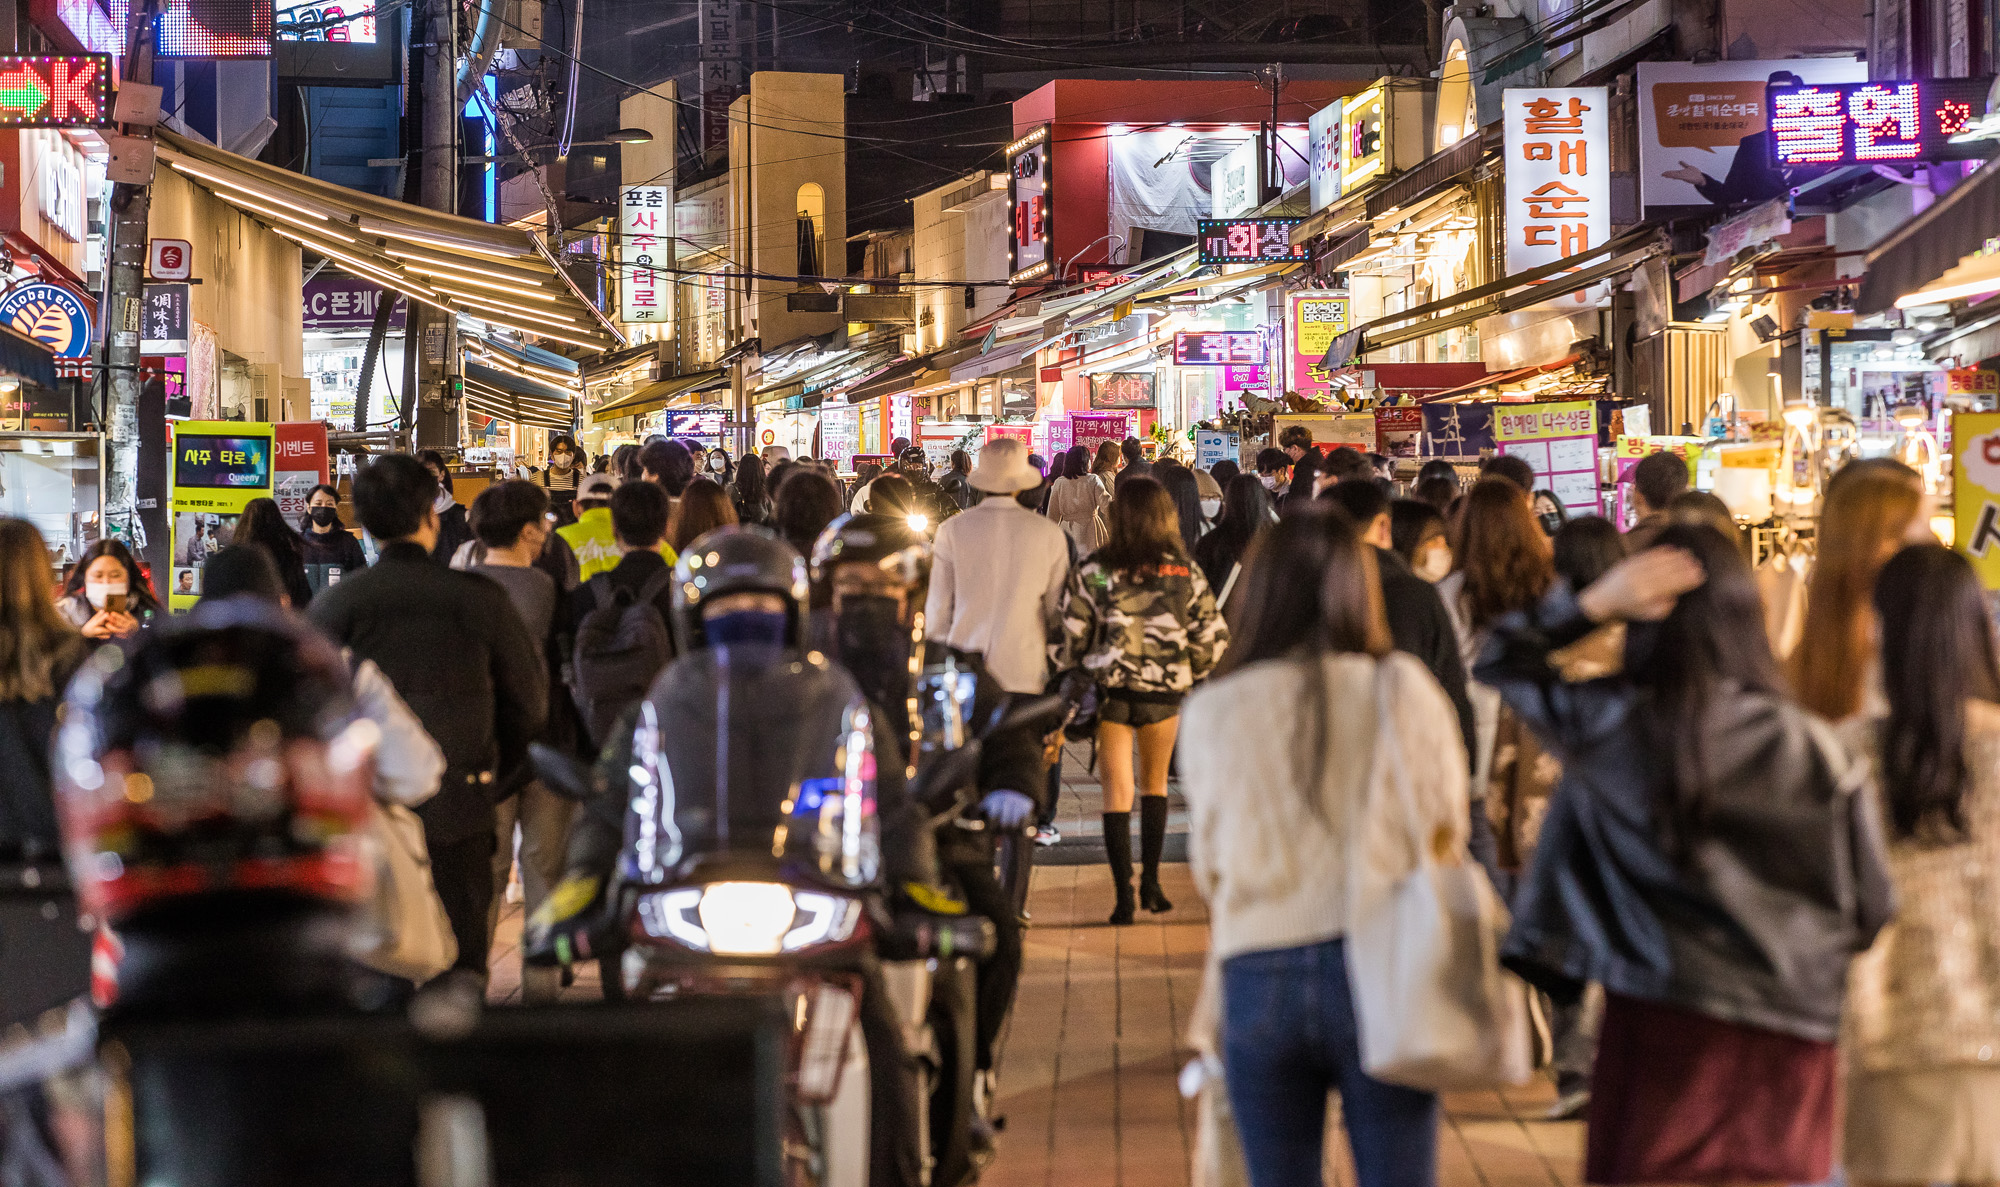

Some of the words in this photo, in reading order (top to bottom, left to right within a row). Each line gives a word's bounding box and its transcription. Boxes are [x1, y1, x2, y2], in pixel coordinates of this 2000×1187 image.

[53, 61, 96, 119] K
[1772, 83, 1921, 163] 출연
[626, 190, 662, 208] 포춘
[5, 289, 51, 315] global
[55, 293, 78, 317] eco
[635, 311, 654, 319] 2F
[1303, 313, 1345, 323] 바이러스
[1501, 413, 1538, 436] 연예인
[1542, 410, 1592, 433] 다수상담
[275, 440, 316, 457] 이벤트
[827, 441, 844, 450] BIG
[184, 449, 211, 465] 사주
[220, 451, 246, 465] 타로
[825, 451, 843, 459] SAL
[228, 473, 260, 483] Queeny
[280, 497, 305, 512] 증정
